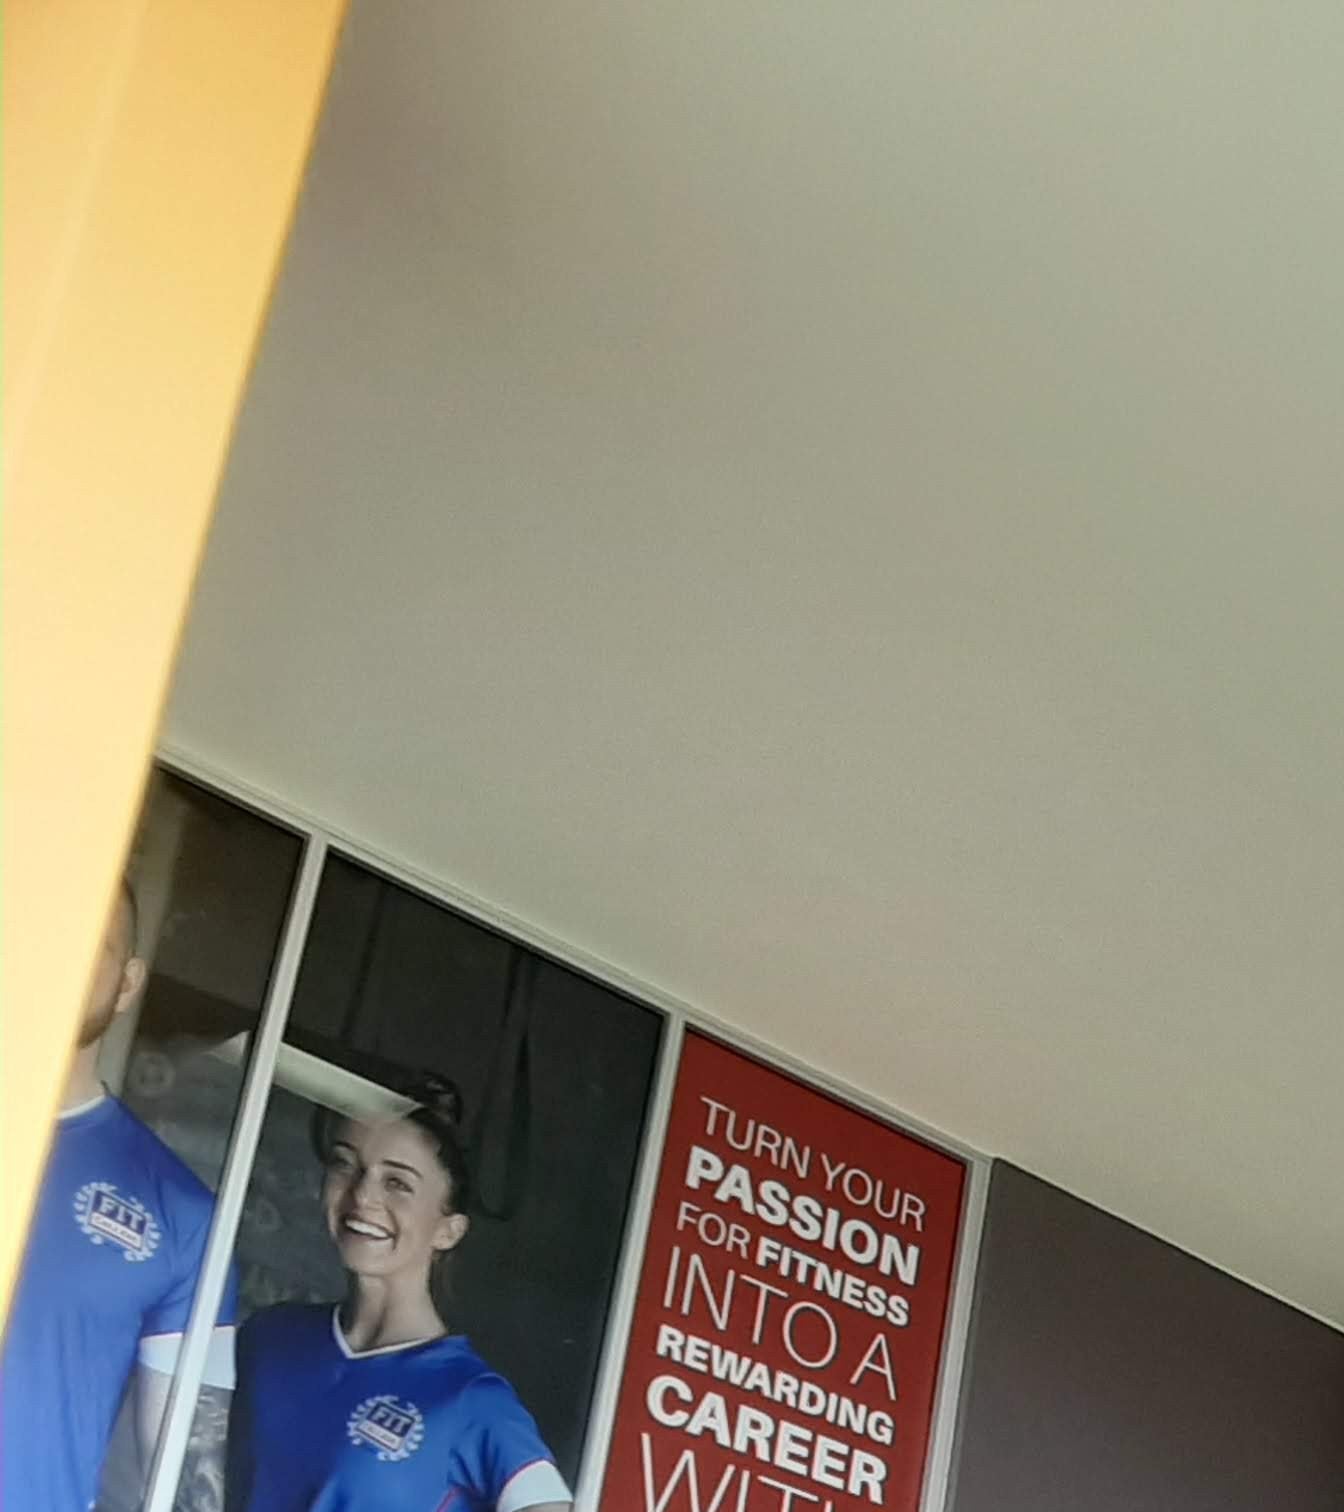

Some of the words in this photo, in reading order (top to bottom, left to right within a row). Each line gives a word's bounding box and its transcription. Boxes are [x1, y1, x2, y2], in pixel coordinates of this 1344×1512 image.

[99, 1195, 144, 1231] FIT
[685, 1145, 920, 1285] PASSION
[701, 1095, 811, 1179] TURN
[821, 1153, 927, 1232] YOUR
[664, 1246, 838, 1368] INTO
[850, 1333, 897, 1401] A
[676, 1201, 751, 1260] FOR
[756, 1236, 909, 1327] FITNESS
[371, 1406, 411, 1433] FIT
[646, 1375, 887, 1504] CAREER
[656, 1325, 894, 1446] REWARDING
